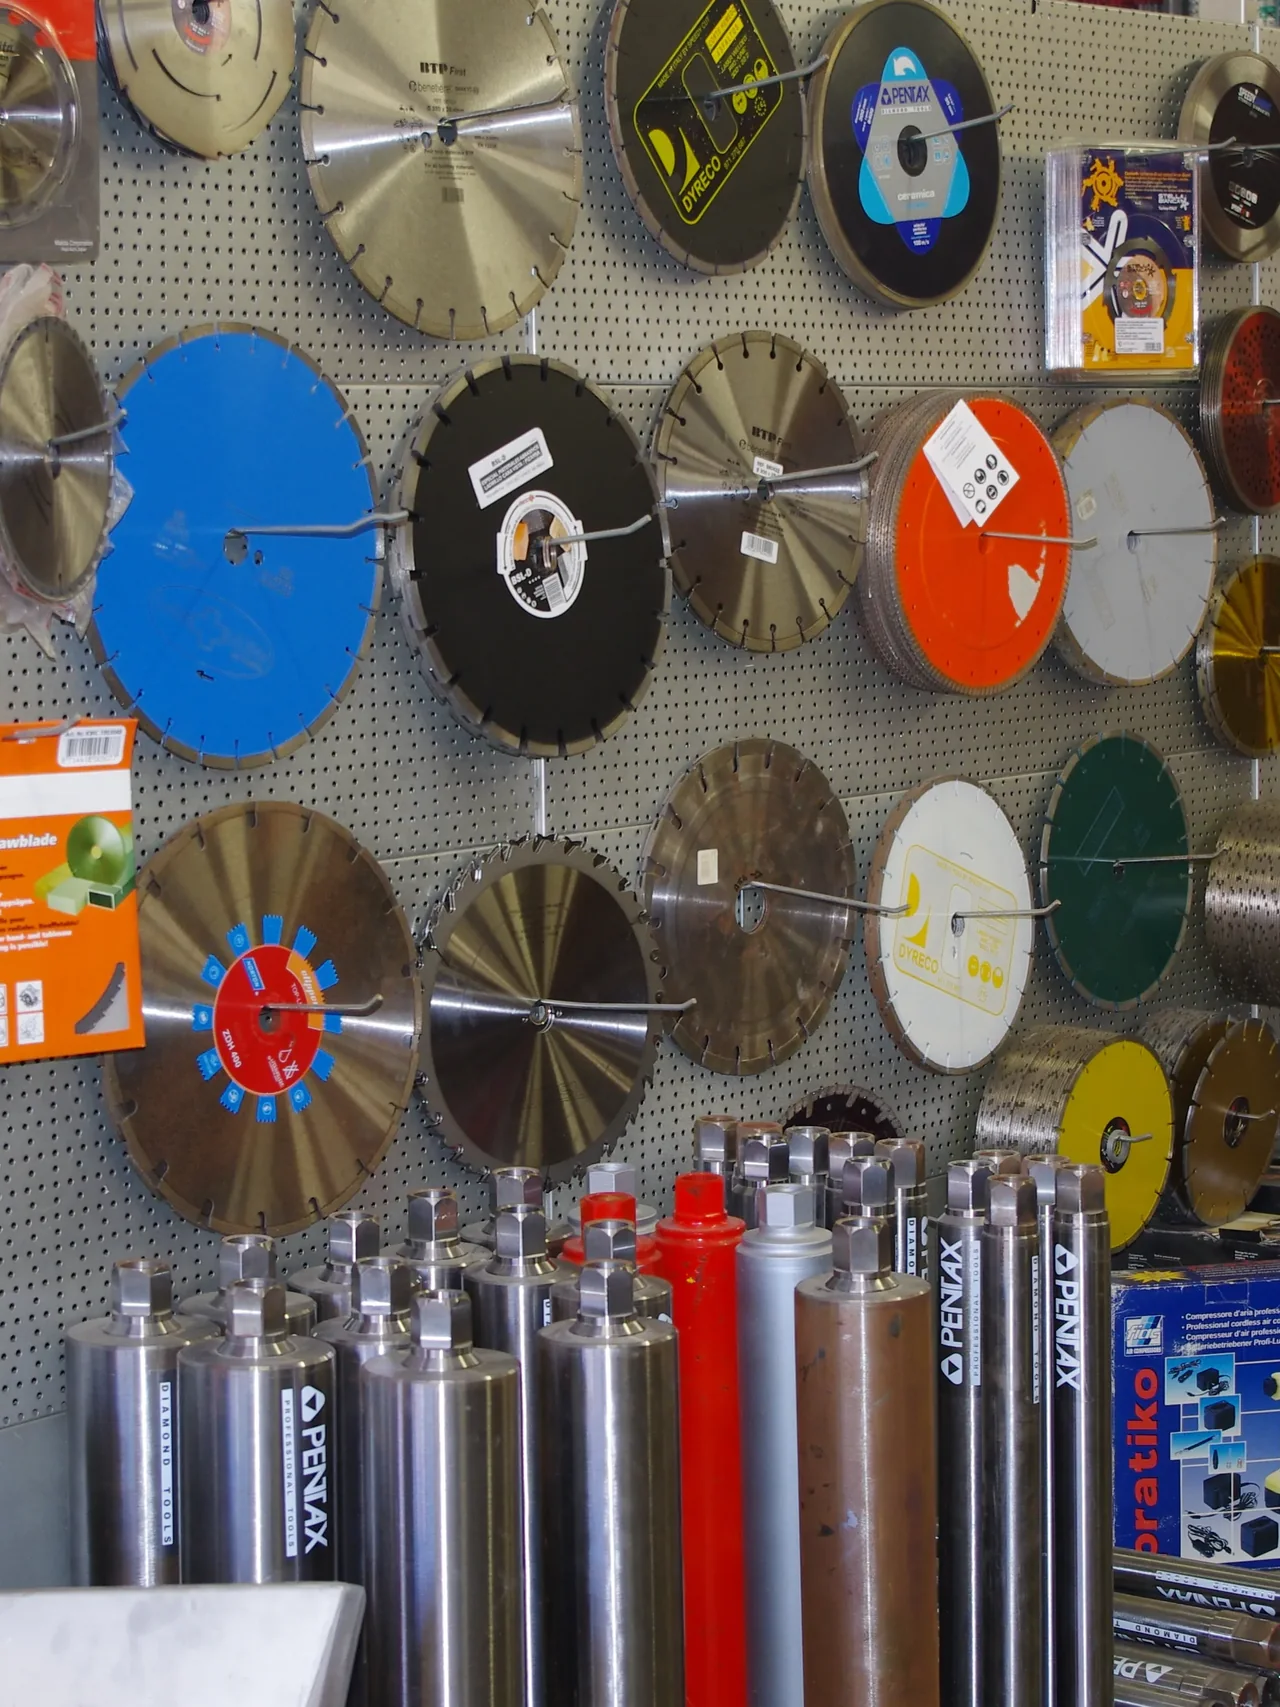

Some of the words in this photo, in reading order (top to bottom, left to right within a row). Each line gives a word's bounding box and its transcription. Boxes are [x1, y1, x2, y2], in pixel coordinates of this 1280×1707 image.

[420, 62, 448, 74] BTP
[892, 85, 930, 104] PENTAX
[682, 155, 722, 213] DYRECO
[897, 189, 935, 200] ceramica
[752, 426, 776, 442] BTP
[511, 567, 532, 585] BSL-D
[899, 943, 939, 974] DYRECO
[246, 960, 260, 988] NORTON
[222, 1029, 235, 1051] ZDH
[231, 1051, 242, 1068] 400
[941, 1237, 963, 1348] PENTAX
[1185, 1311, 1232, 1321] Compressore
[1234, 1309, 1253, 1317] d'aria
[1186, 1321, 1230, 1330] Professional
[1055, 1280, 1081, 1391] PENTAX
[1186, 1331, 1233, 1341] Compresseur
[161, 1384, 170, 1466] DIAMOND
[284, 1400, 293, 1496] PROFESSIONAL
[302, 1425, 328, 1554] PENTAX
[163, 1487, 172, 1543] TOOLS
[287, 1508, 295, 1547] TOOLS
[1135, 1624, 1195, 1644] DIAMOND
